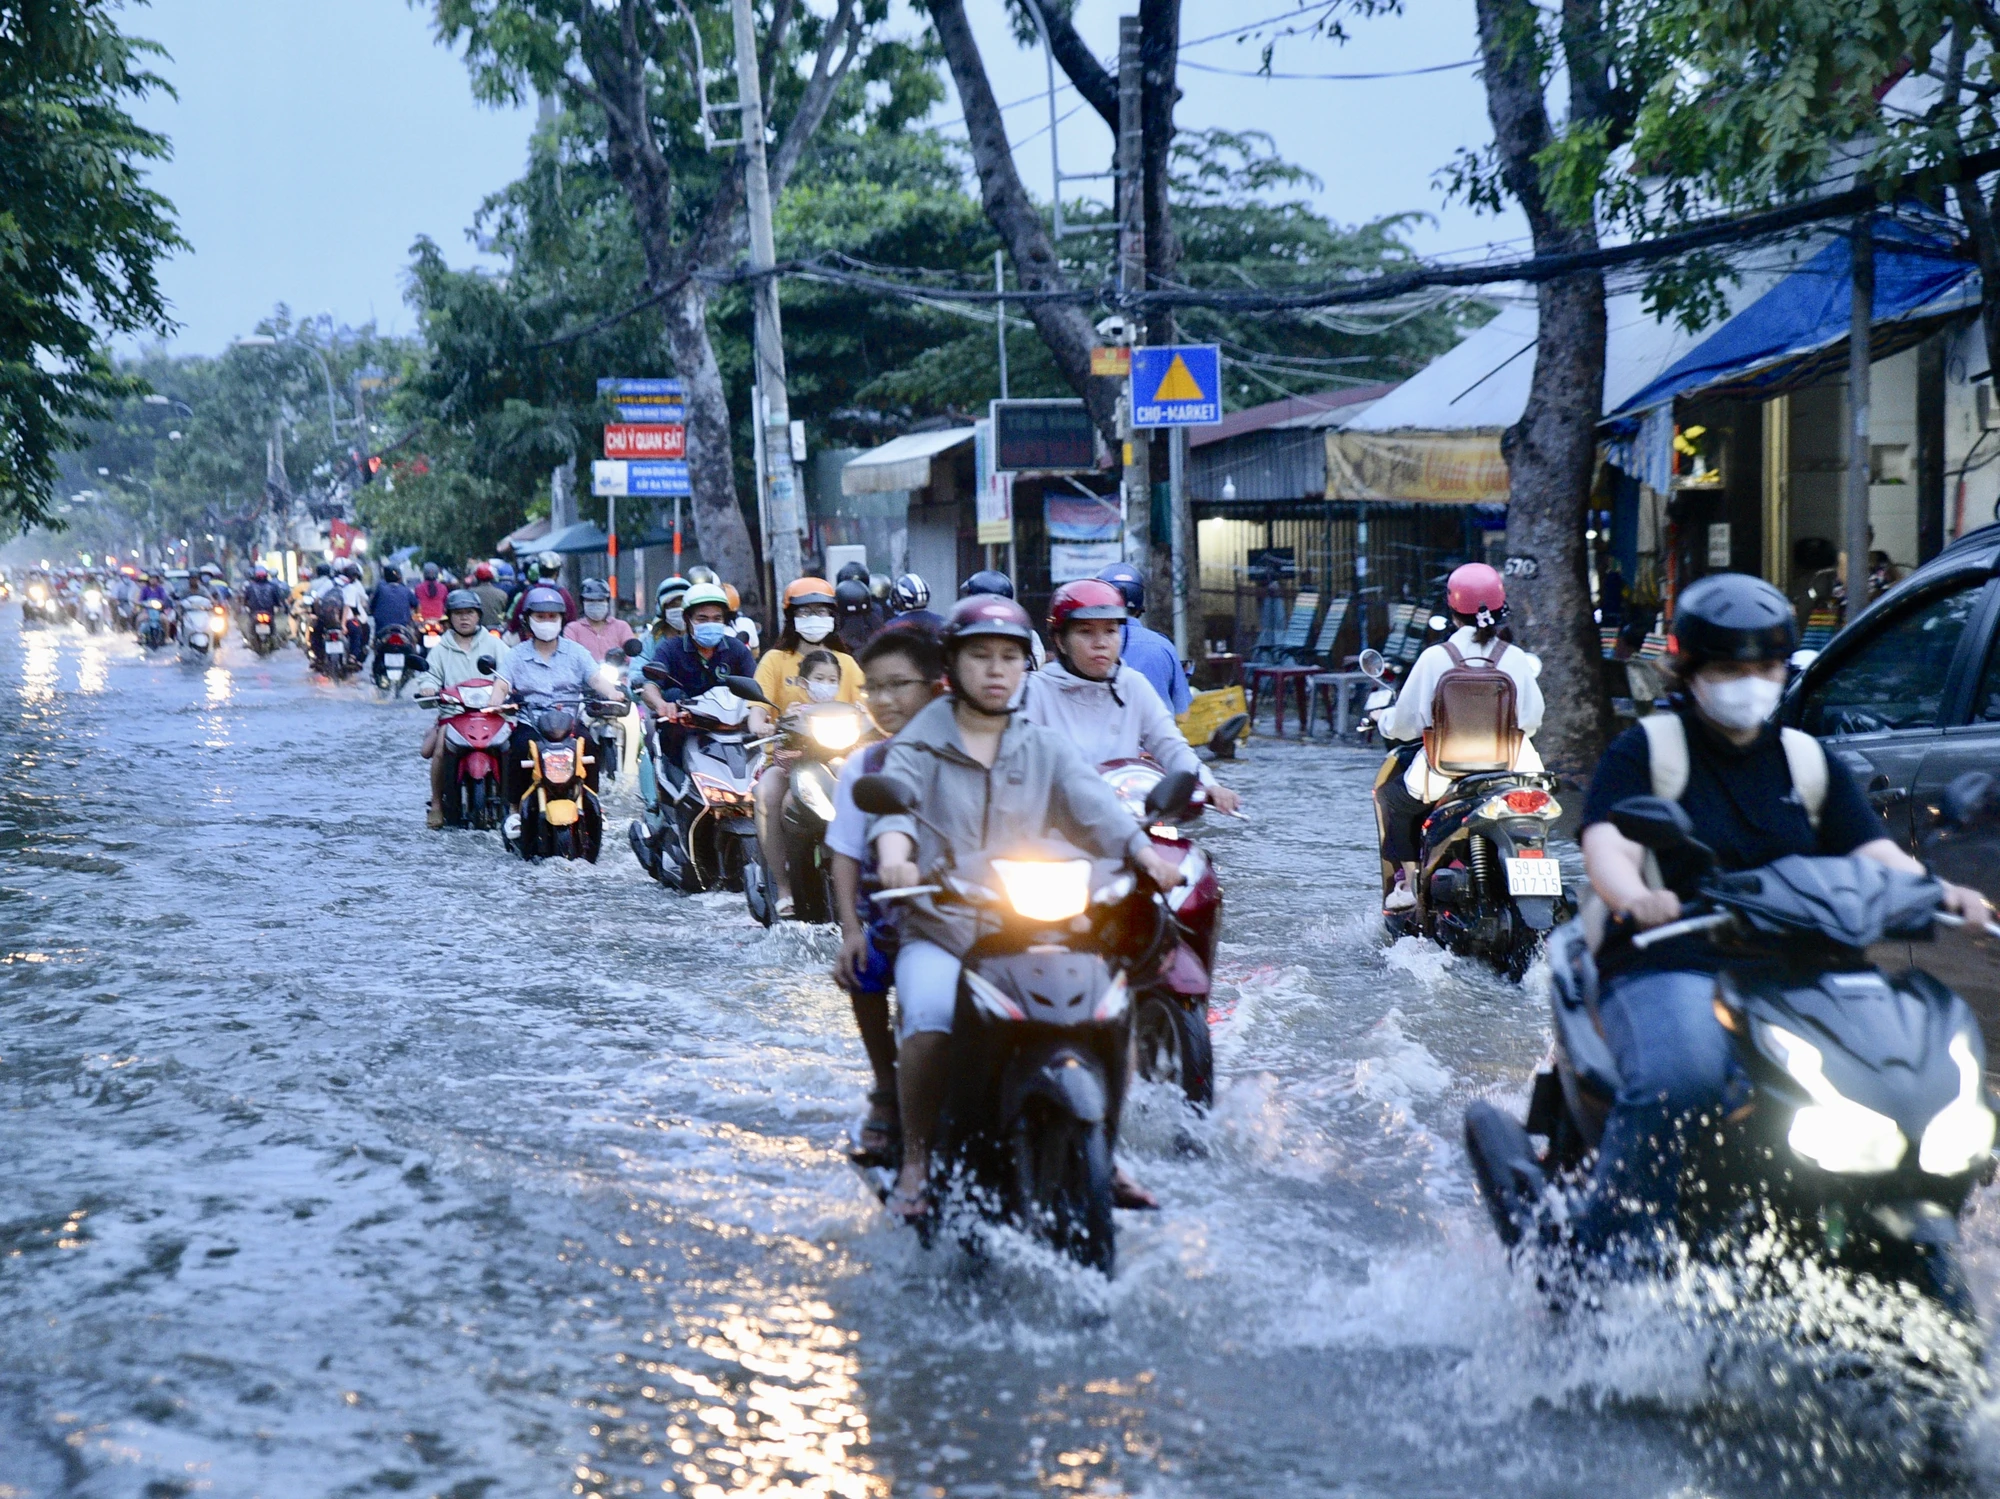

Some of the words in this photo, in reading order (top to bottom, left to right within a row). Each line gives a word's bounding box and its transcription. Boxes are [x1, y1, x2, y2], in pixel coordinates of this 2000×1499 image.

[606, 427, 626, 450] CHÚ
[635, 431, 663, 450] QUAN
[664, 427, 682, 450] SÁT
